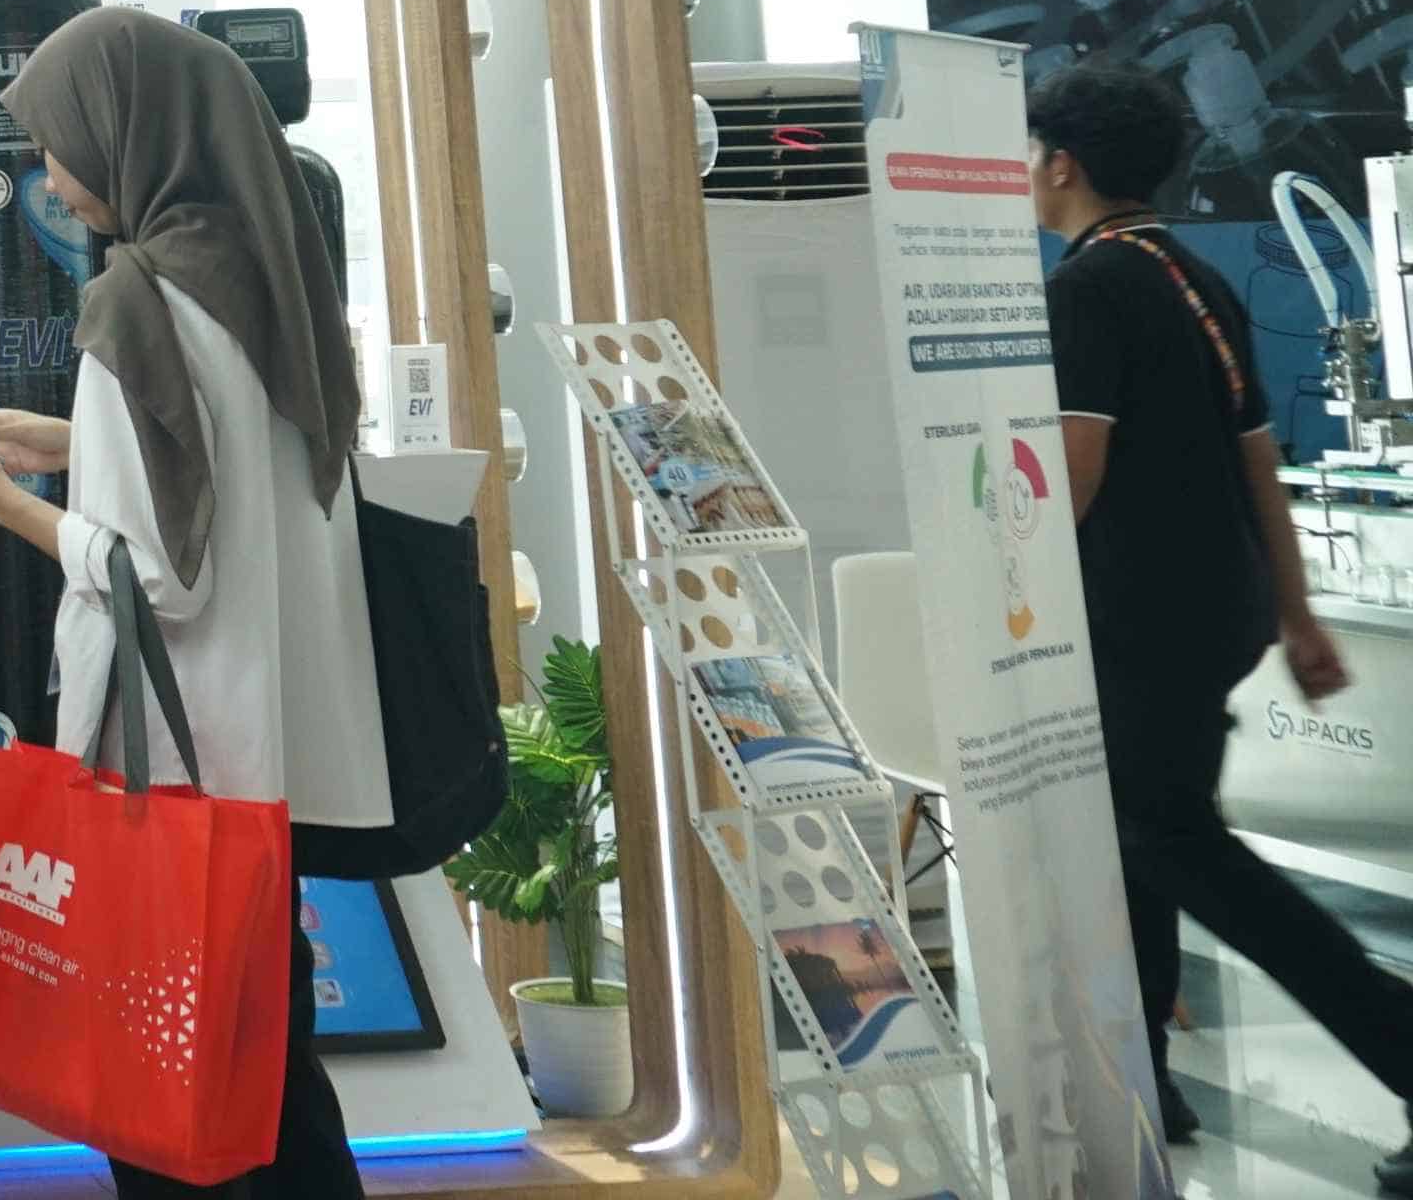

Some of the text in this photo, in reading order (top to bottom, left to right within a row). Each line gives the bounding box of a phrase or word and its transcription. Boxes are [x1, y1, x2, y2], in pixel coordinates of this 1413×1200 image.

[913, 343, 935, 362] WE
[1295, 716, 1374, 750] JPACKS
[28, 941, 61, 968] clean
